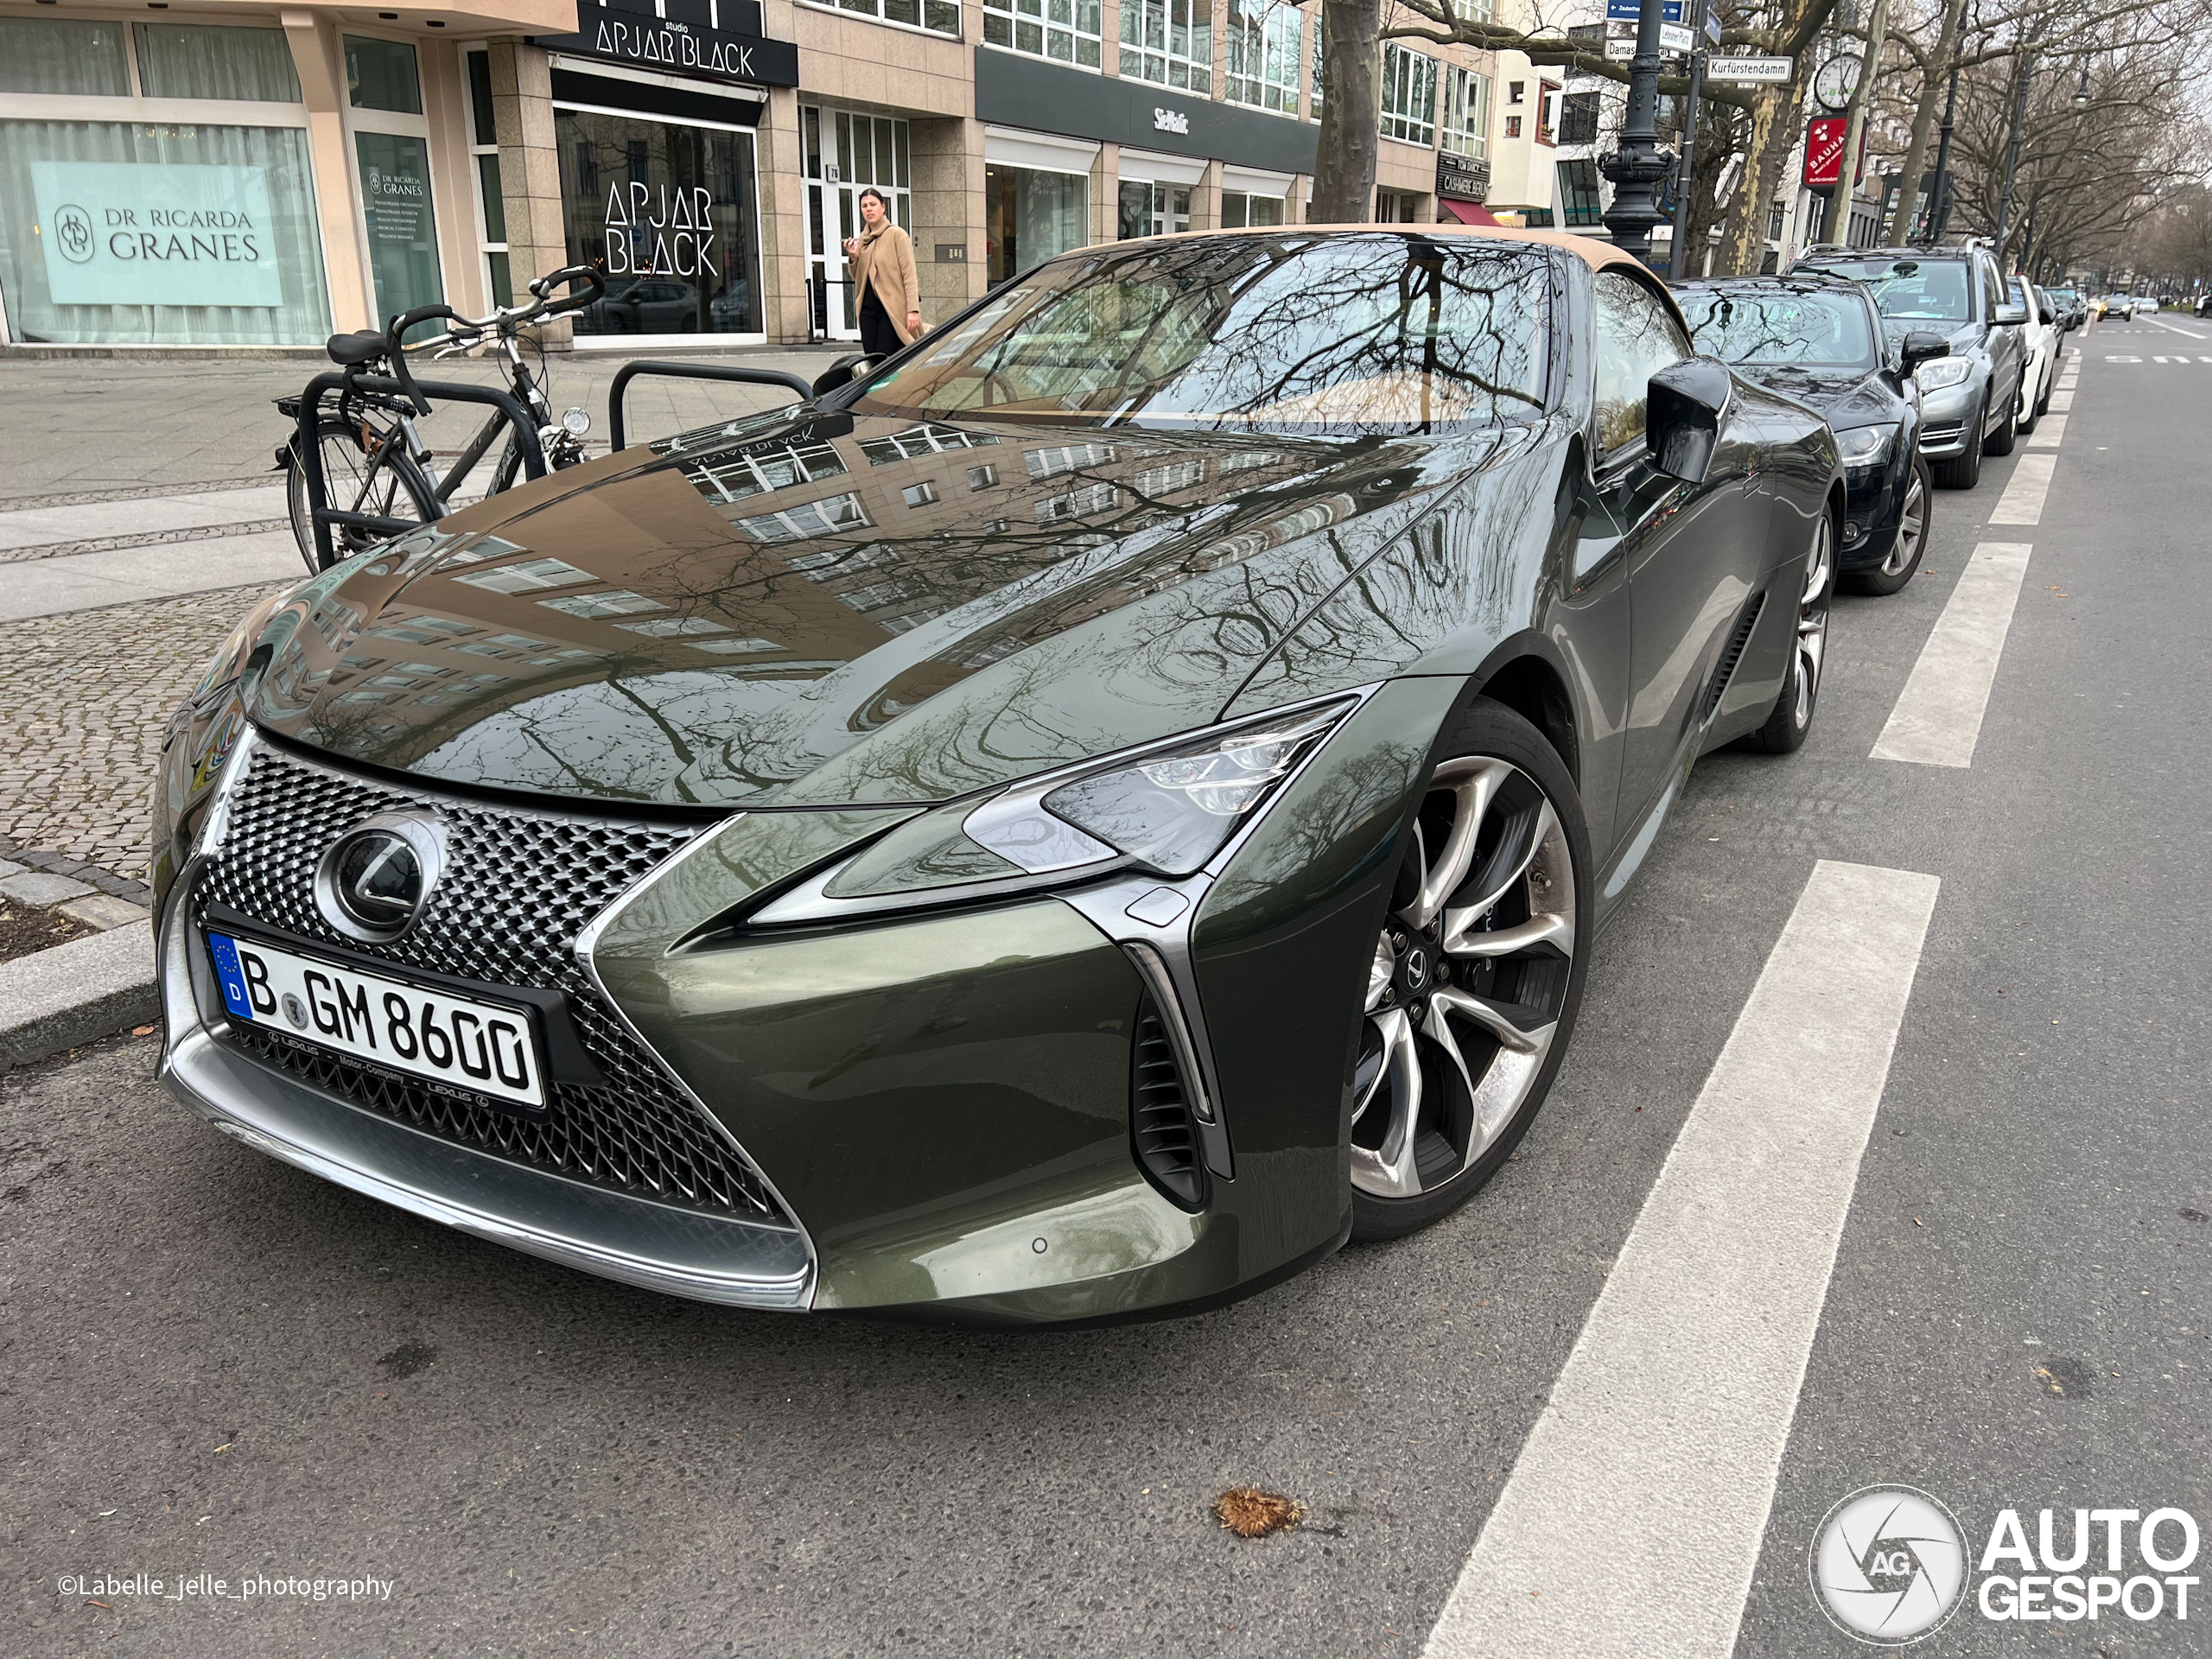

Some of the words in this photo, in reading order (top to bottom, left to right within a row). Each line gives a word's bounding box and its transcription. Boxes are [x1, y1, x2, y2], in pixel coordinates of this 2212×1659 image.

[665, 21, 688, 34] studio
[1662, 26, 1679, 41] Lehniner
[1679, 30, 1689, 45] Platz
[681, 33, 755, 77] BLACK
[1711, 60, 1785, 74] Kurfürstendamm
[1809, 134, 1845, 169] BAUHA
[383, 175, 391, 183] DR
[394, 175, 421, 185] RICARDA
[830, 168, 838, 179] 76
[383, 182, 423, 196] GRANES
[105, 208, 139, 227] DR
[149, 208, 252, 228] RICARDA
[109, 231, 259, 261] GRANES
[605, 228, 718, 276] BLACK
[228, 982, 241, 1001] D
[239, 949, 276, 1016] B
[303, 969, 378, 1049] GM
[383, 991, 530, 1090] 8600
[281, 1037, 320, 1056] LEXUS
[339, 1055, 404, 1084] Motor-Company
[426, 1082, 472, 1103] LEXUS
